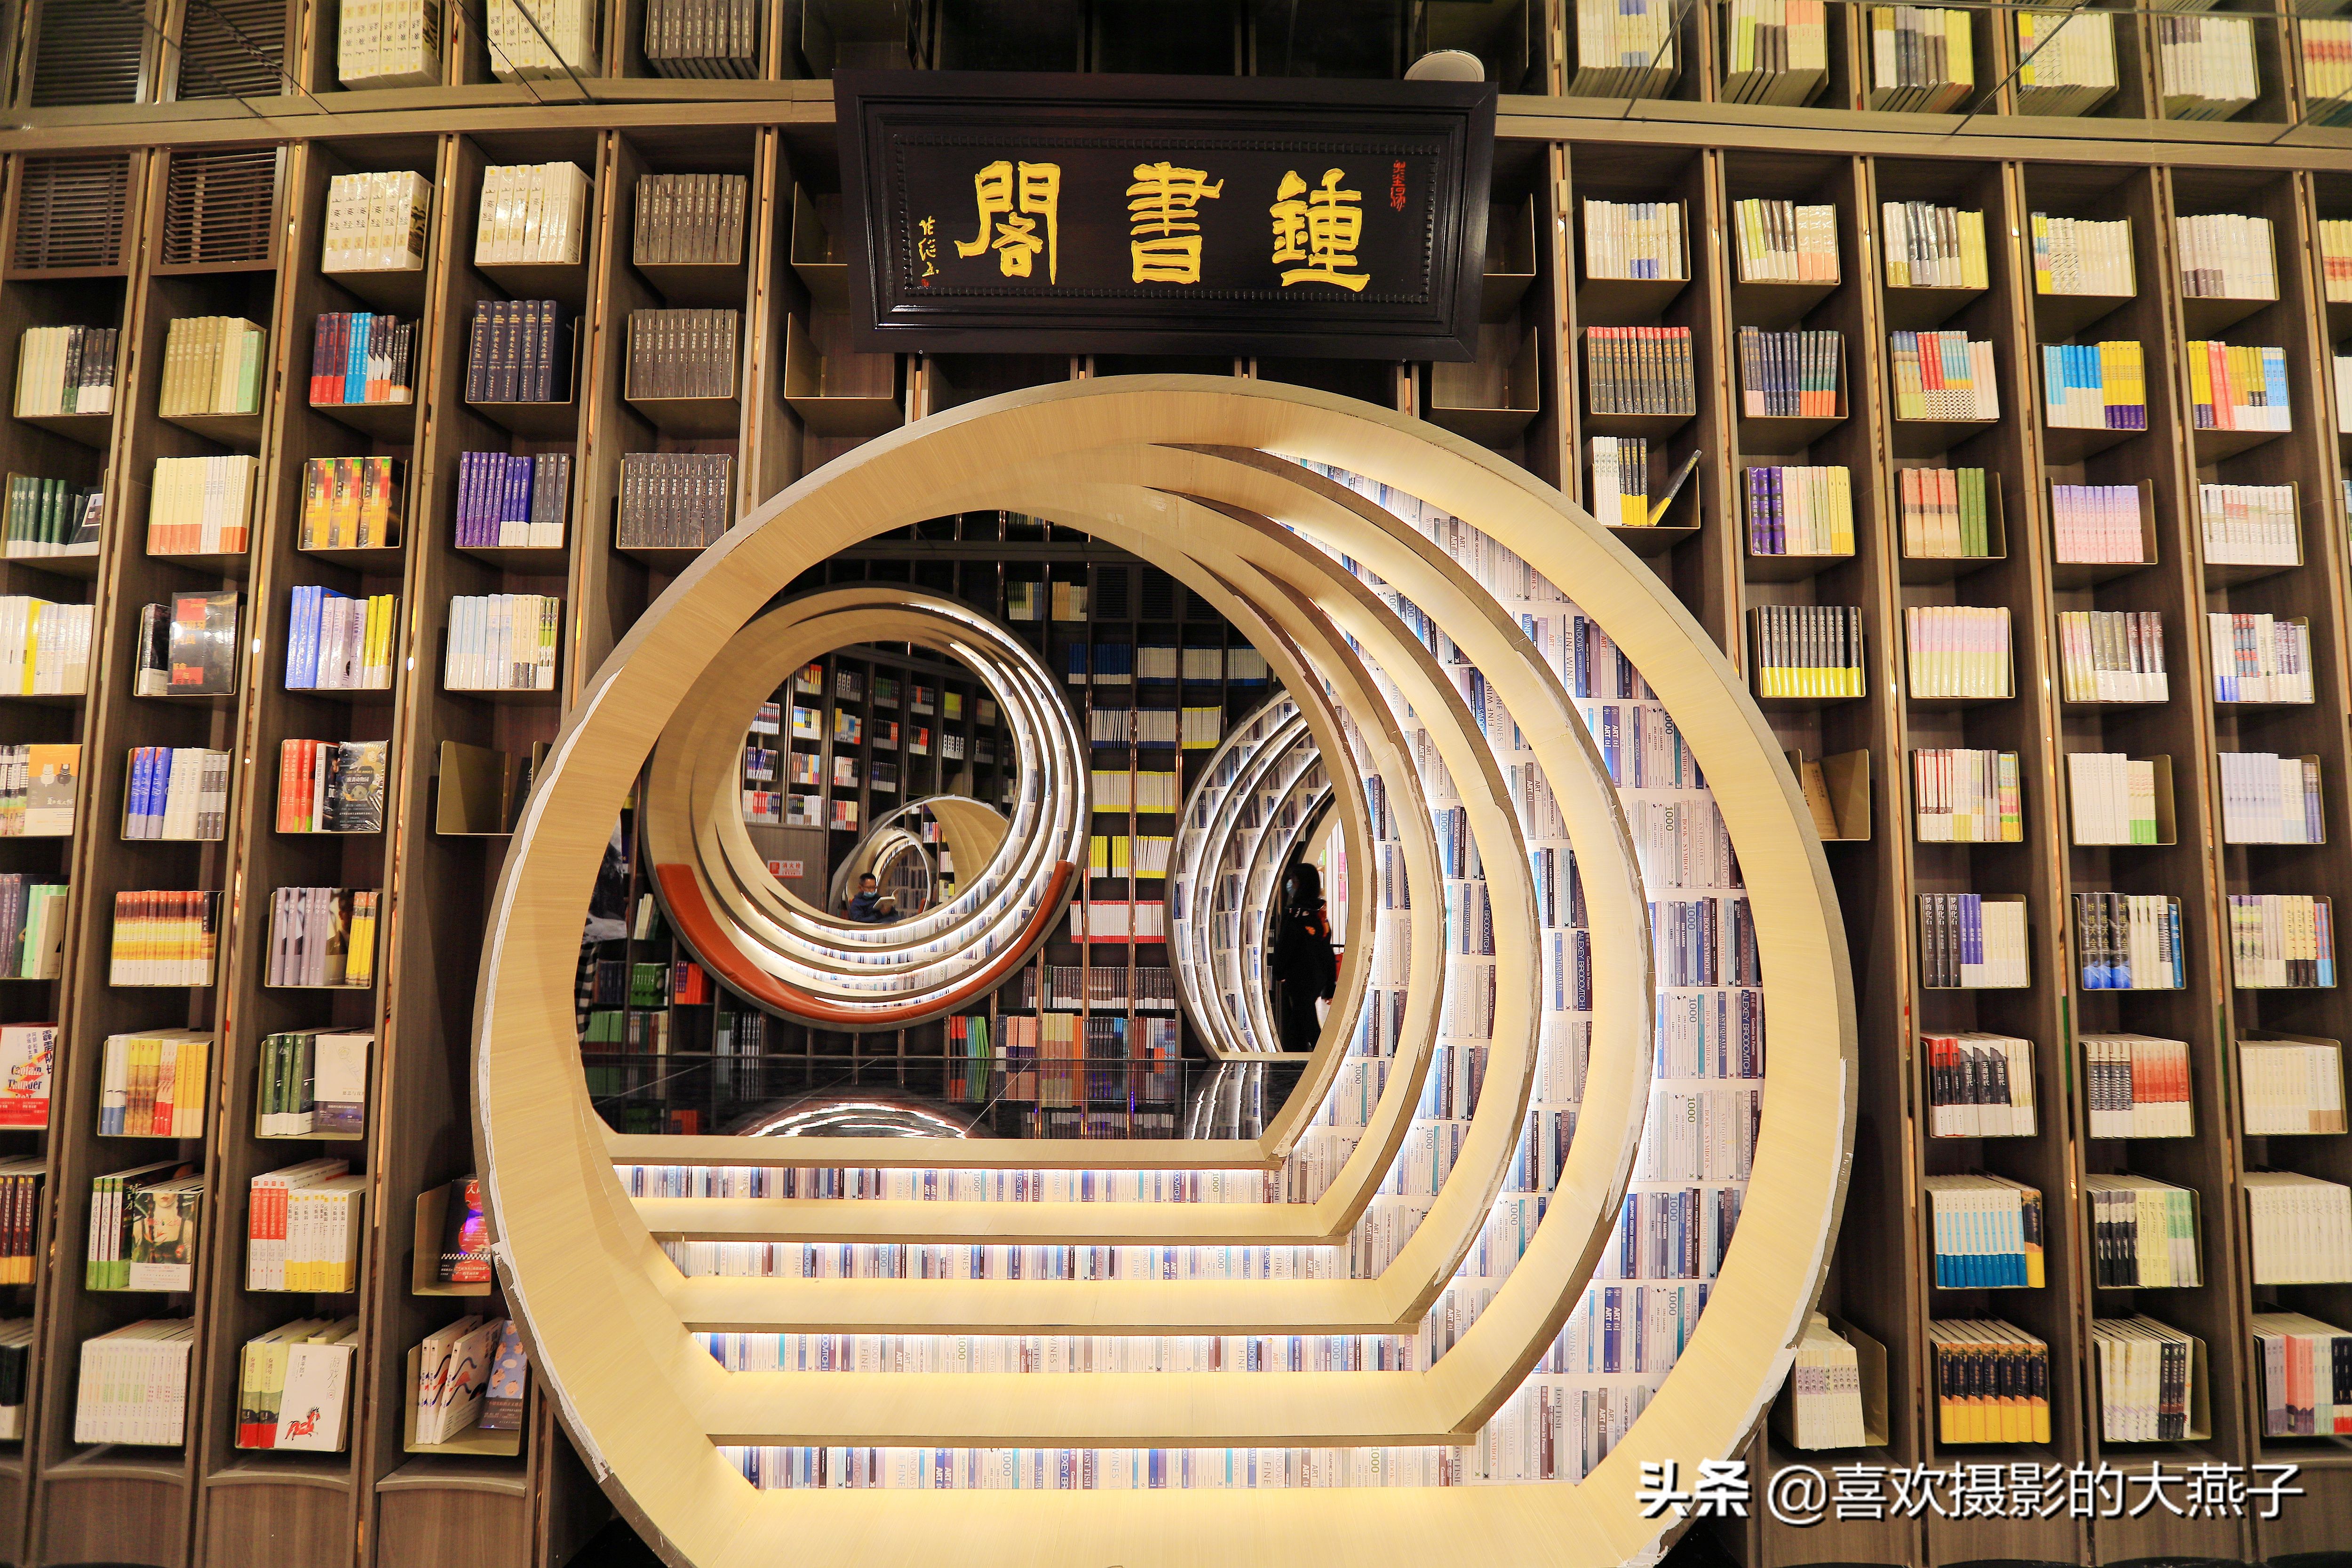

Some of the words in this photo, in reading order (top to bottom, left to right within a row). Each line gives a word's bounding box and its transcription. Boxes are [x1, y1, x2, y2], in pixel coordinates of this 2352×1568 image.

[1665, 807, 1674, 831] 1000
[11, 1066, 41, 1075] Captain
[8, 1080, 42, 1090] Thunder
[326, 1356, 340, 1401] 游戏人间
[1371, 1447, 1380, 1473] 1000
